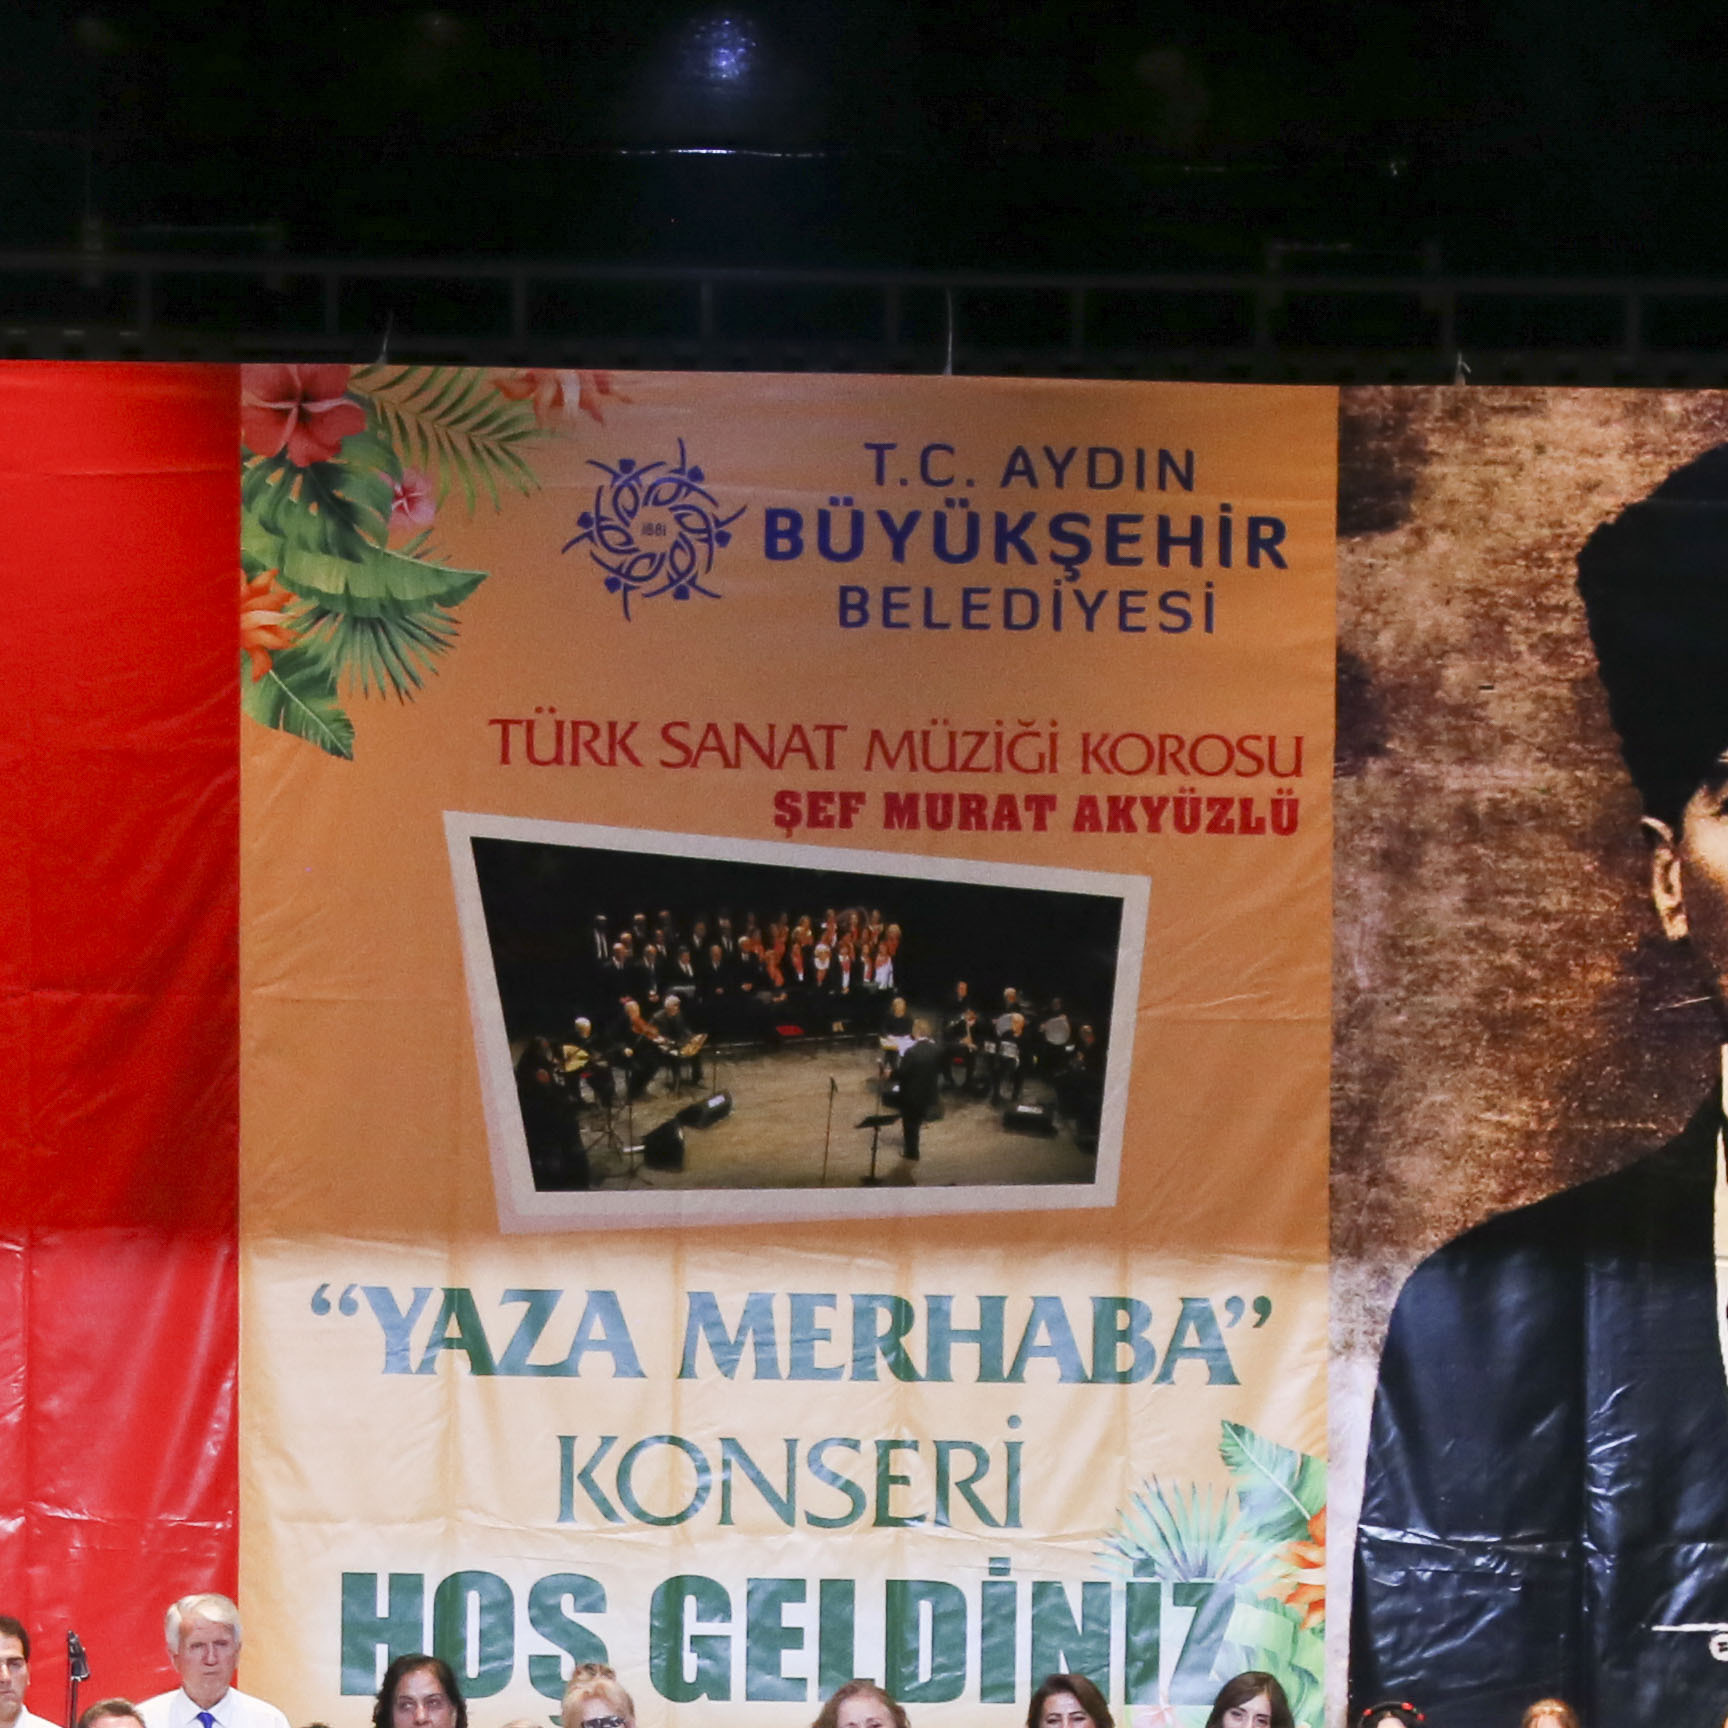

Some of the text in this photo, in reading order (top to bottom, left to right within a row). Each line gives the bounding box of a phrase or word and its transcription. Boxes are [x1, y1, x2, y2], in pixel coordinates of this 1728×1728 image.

[865, 442, 1197, 492] T.C. AYDIN
[763, 497, 1290, 583] BÜYÜKŞEHİR
[837, 579, 1217, 634] BELEDİYESİ
[488, 705, 1305, 778] TÜRK SANAT MÜZİĞİ KOROSU
[773, 787, 1300, 841] ŞEF MURAT AKYÜZLÜ
[556, 1415, 1024, 1529] KONSERİ
[339, 1557, 1236, 1727] HOŞ GELDİNİZ
